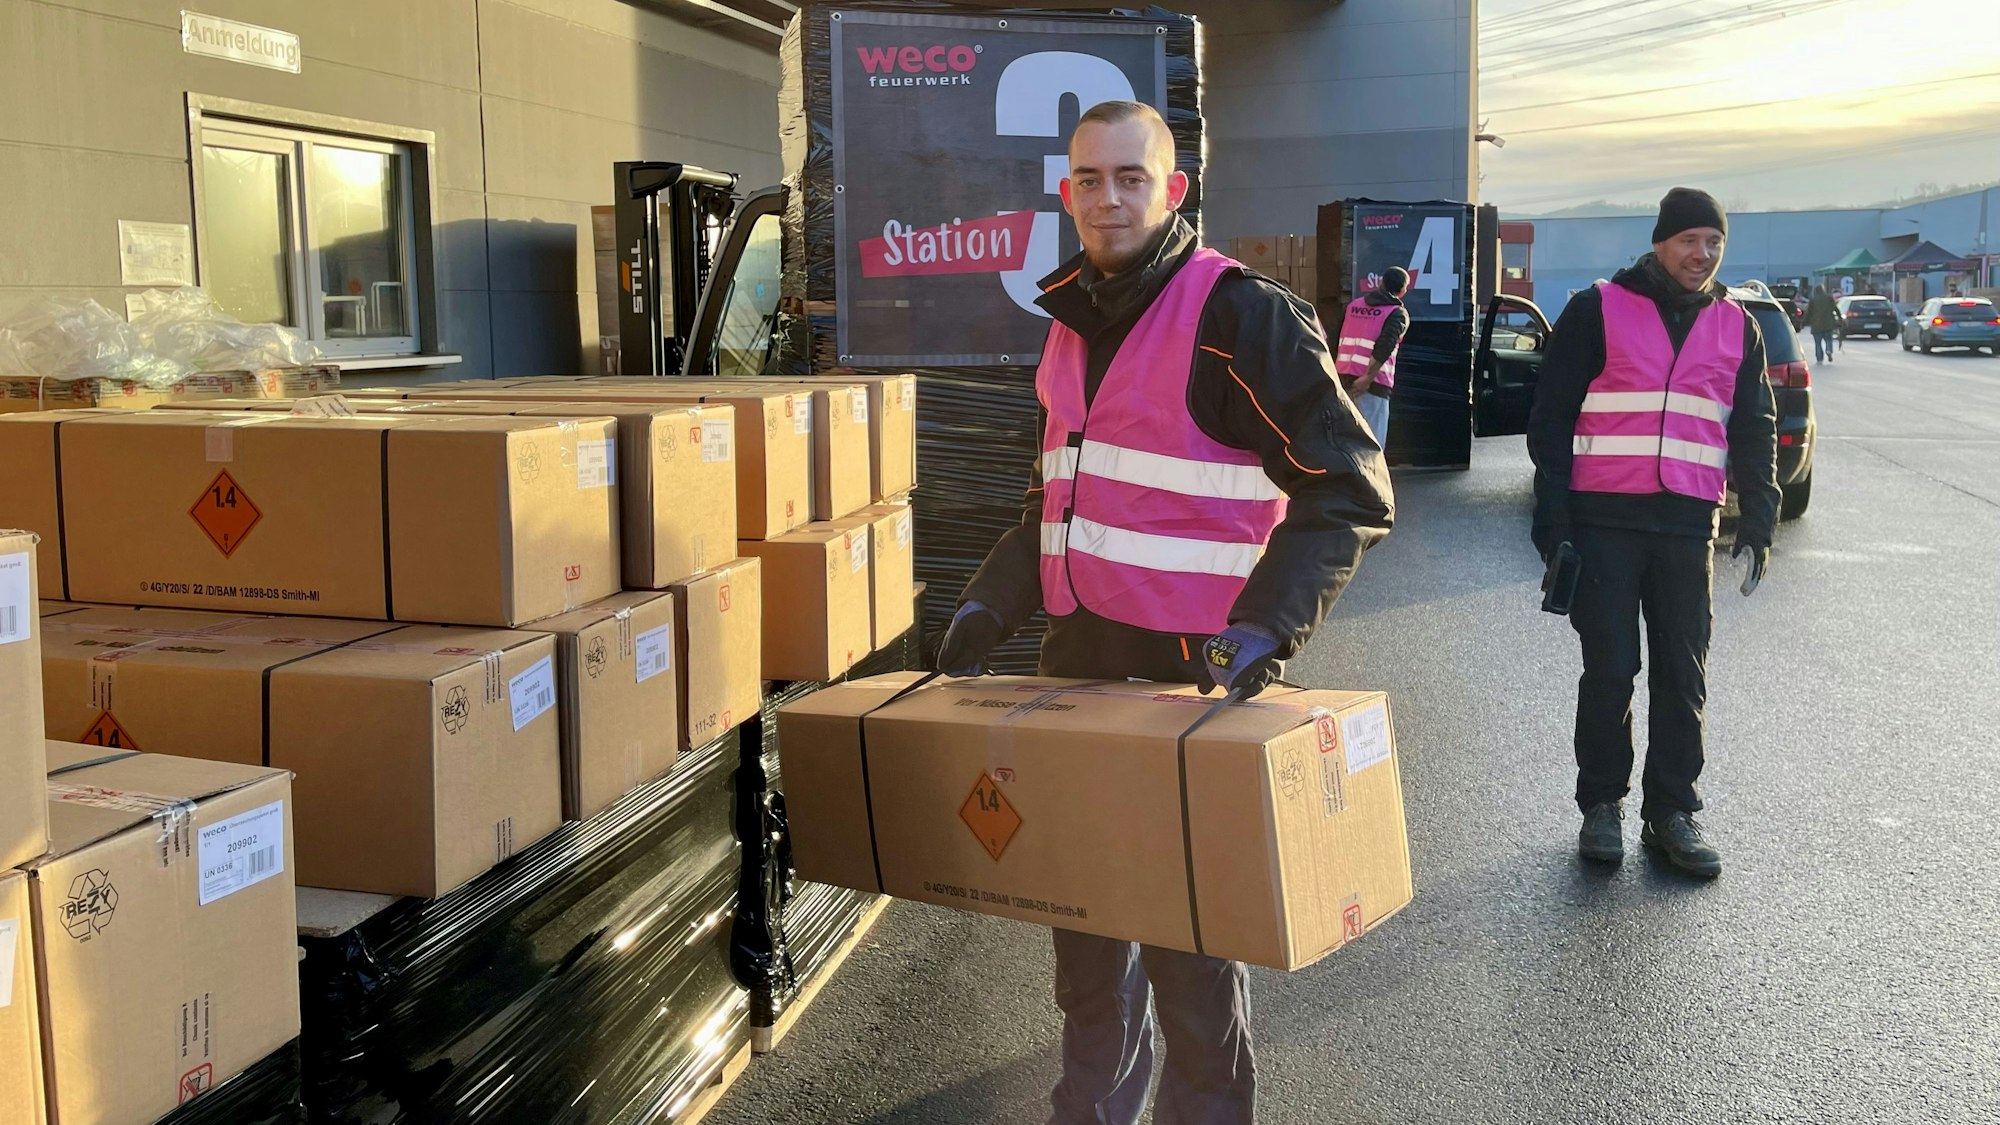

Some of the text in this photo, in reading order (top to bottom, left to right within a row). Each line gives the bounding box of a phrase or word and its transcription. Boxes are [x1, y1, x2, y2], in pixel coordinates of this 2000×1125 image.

[186, 18, 297, 66] Anmeldung
[868, 74, 971, 87] feuerwerk
[882, 217, 1012, 266] Station
[1407, 216, 1460, 305] 4
[630, 239, 643, 313] STILL
[1841, 276, 1854, 296] 6
[212, 485, 238, 508] 1.4
[193, 583, 204, 595] 22
[695, 713, 717, 735] 111-32
[976, 787, 1000, 812] 1.4
[202, 825, 227, 840] weco
[227, 834, 258, 854] 209902
[204, 868, 216, 879] UN
[970, 889, 979, 900] 22
